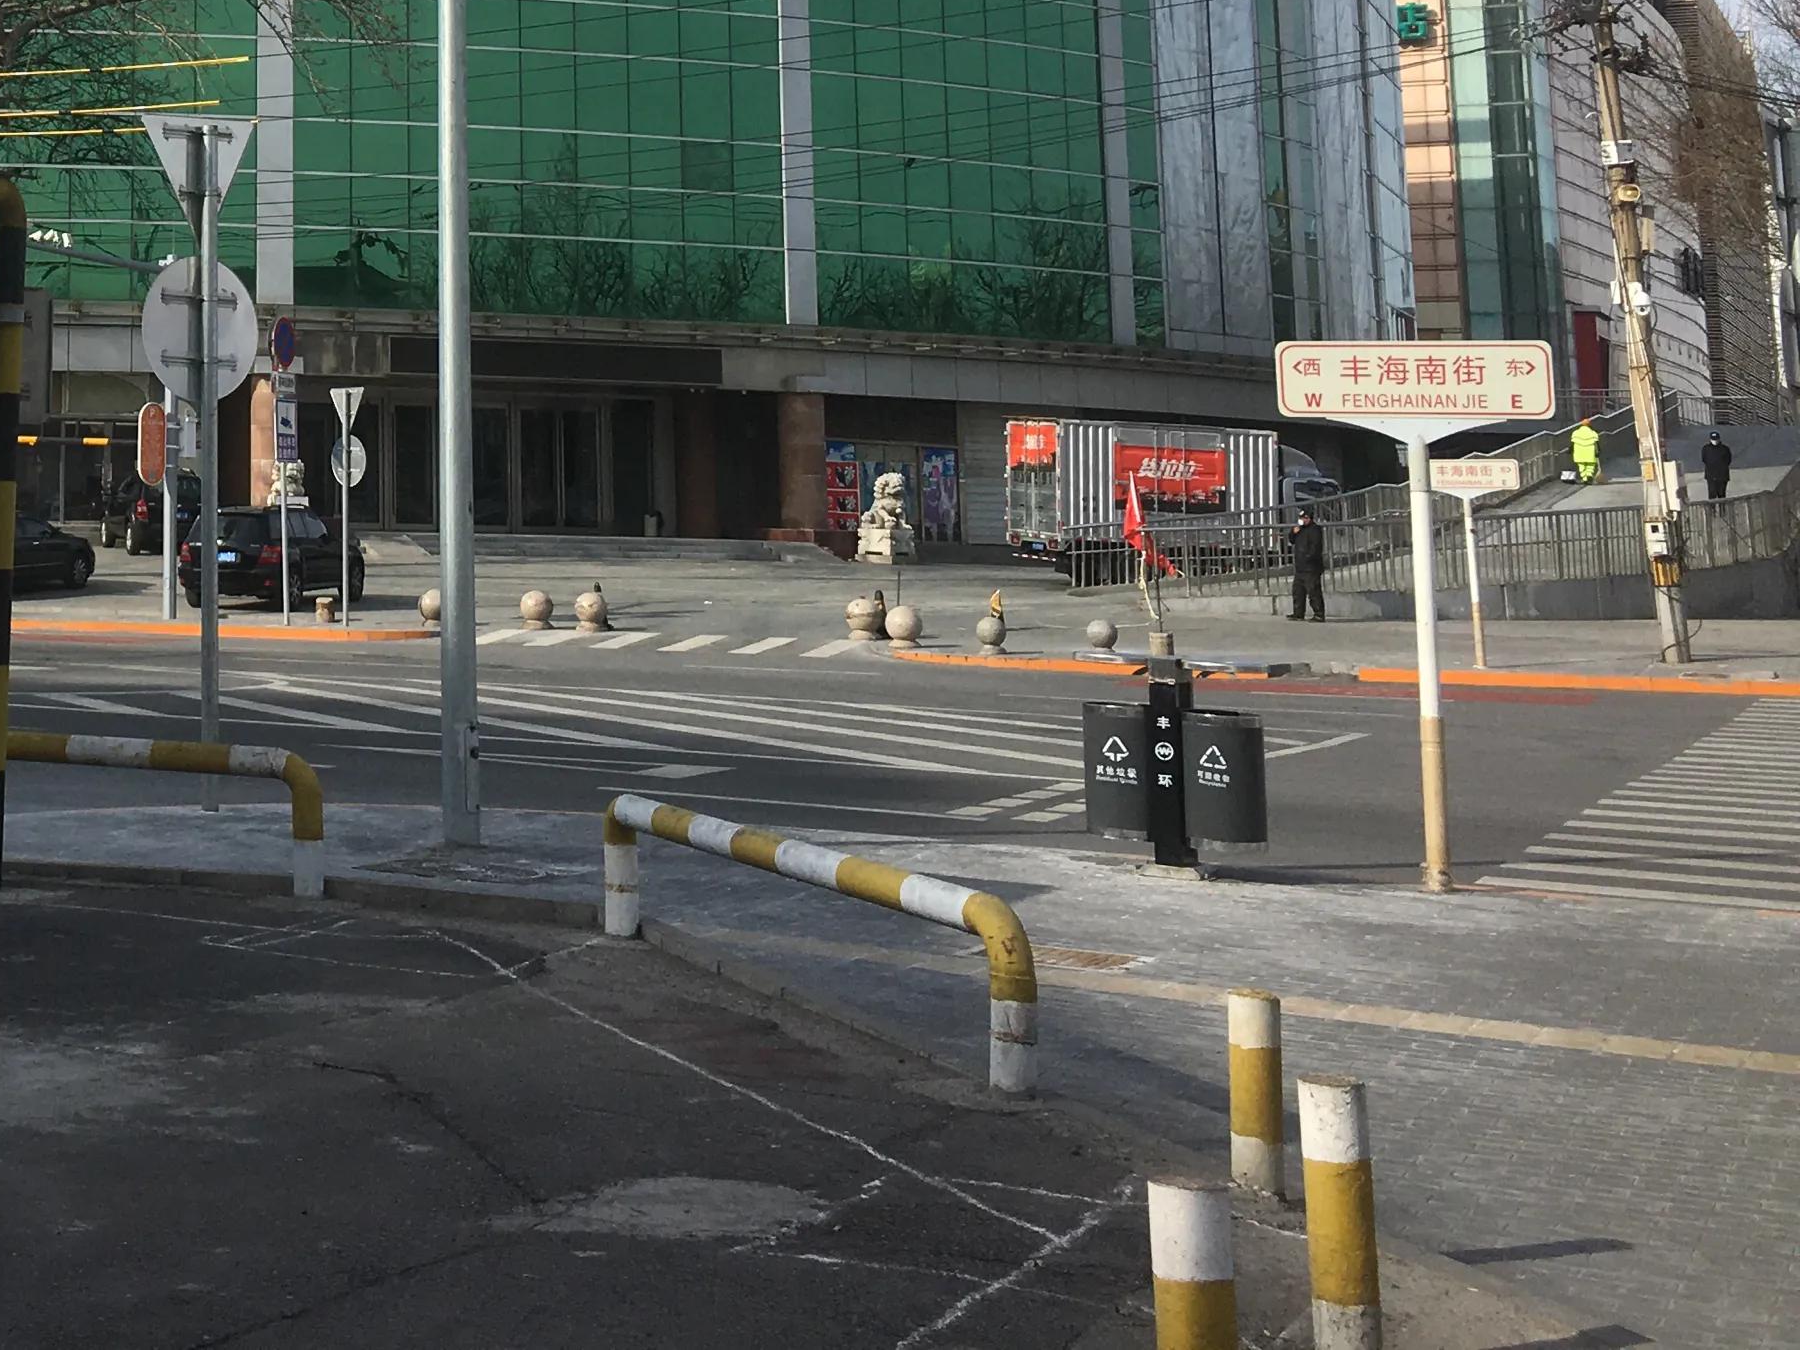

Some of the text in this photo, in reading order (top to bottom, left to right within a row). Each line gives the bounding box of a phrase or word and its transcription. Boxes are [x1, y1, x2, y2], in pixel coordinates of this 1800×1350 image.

[1303, 355, 1525, 386] 西 丰海南街 东
[1305, 393, 1523, 409] W FENGHAINAN JIE E
